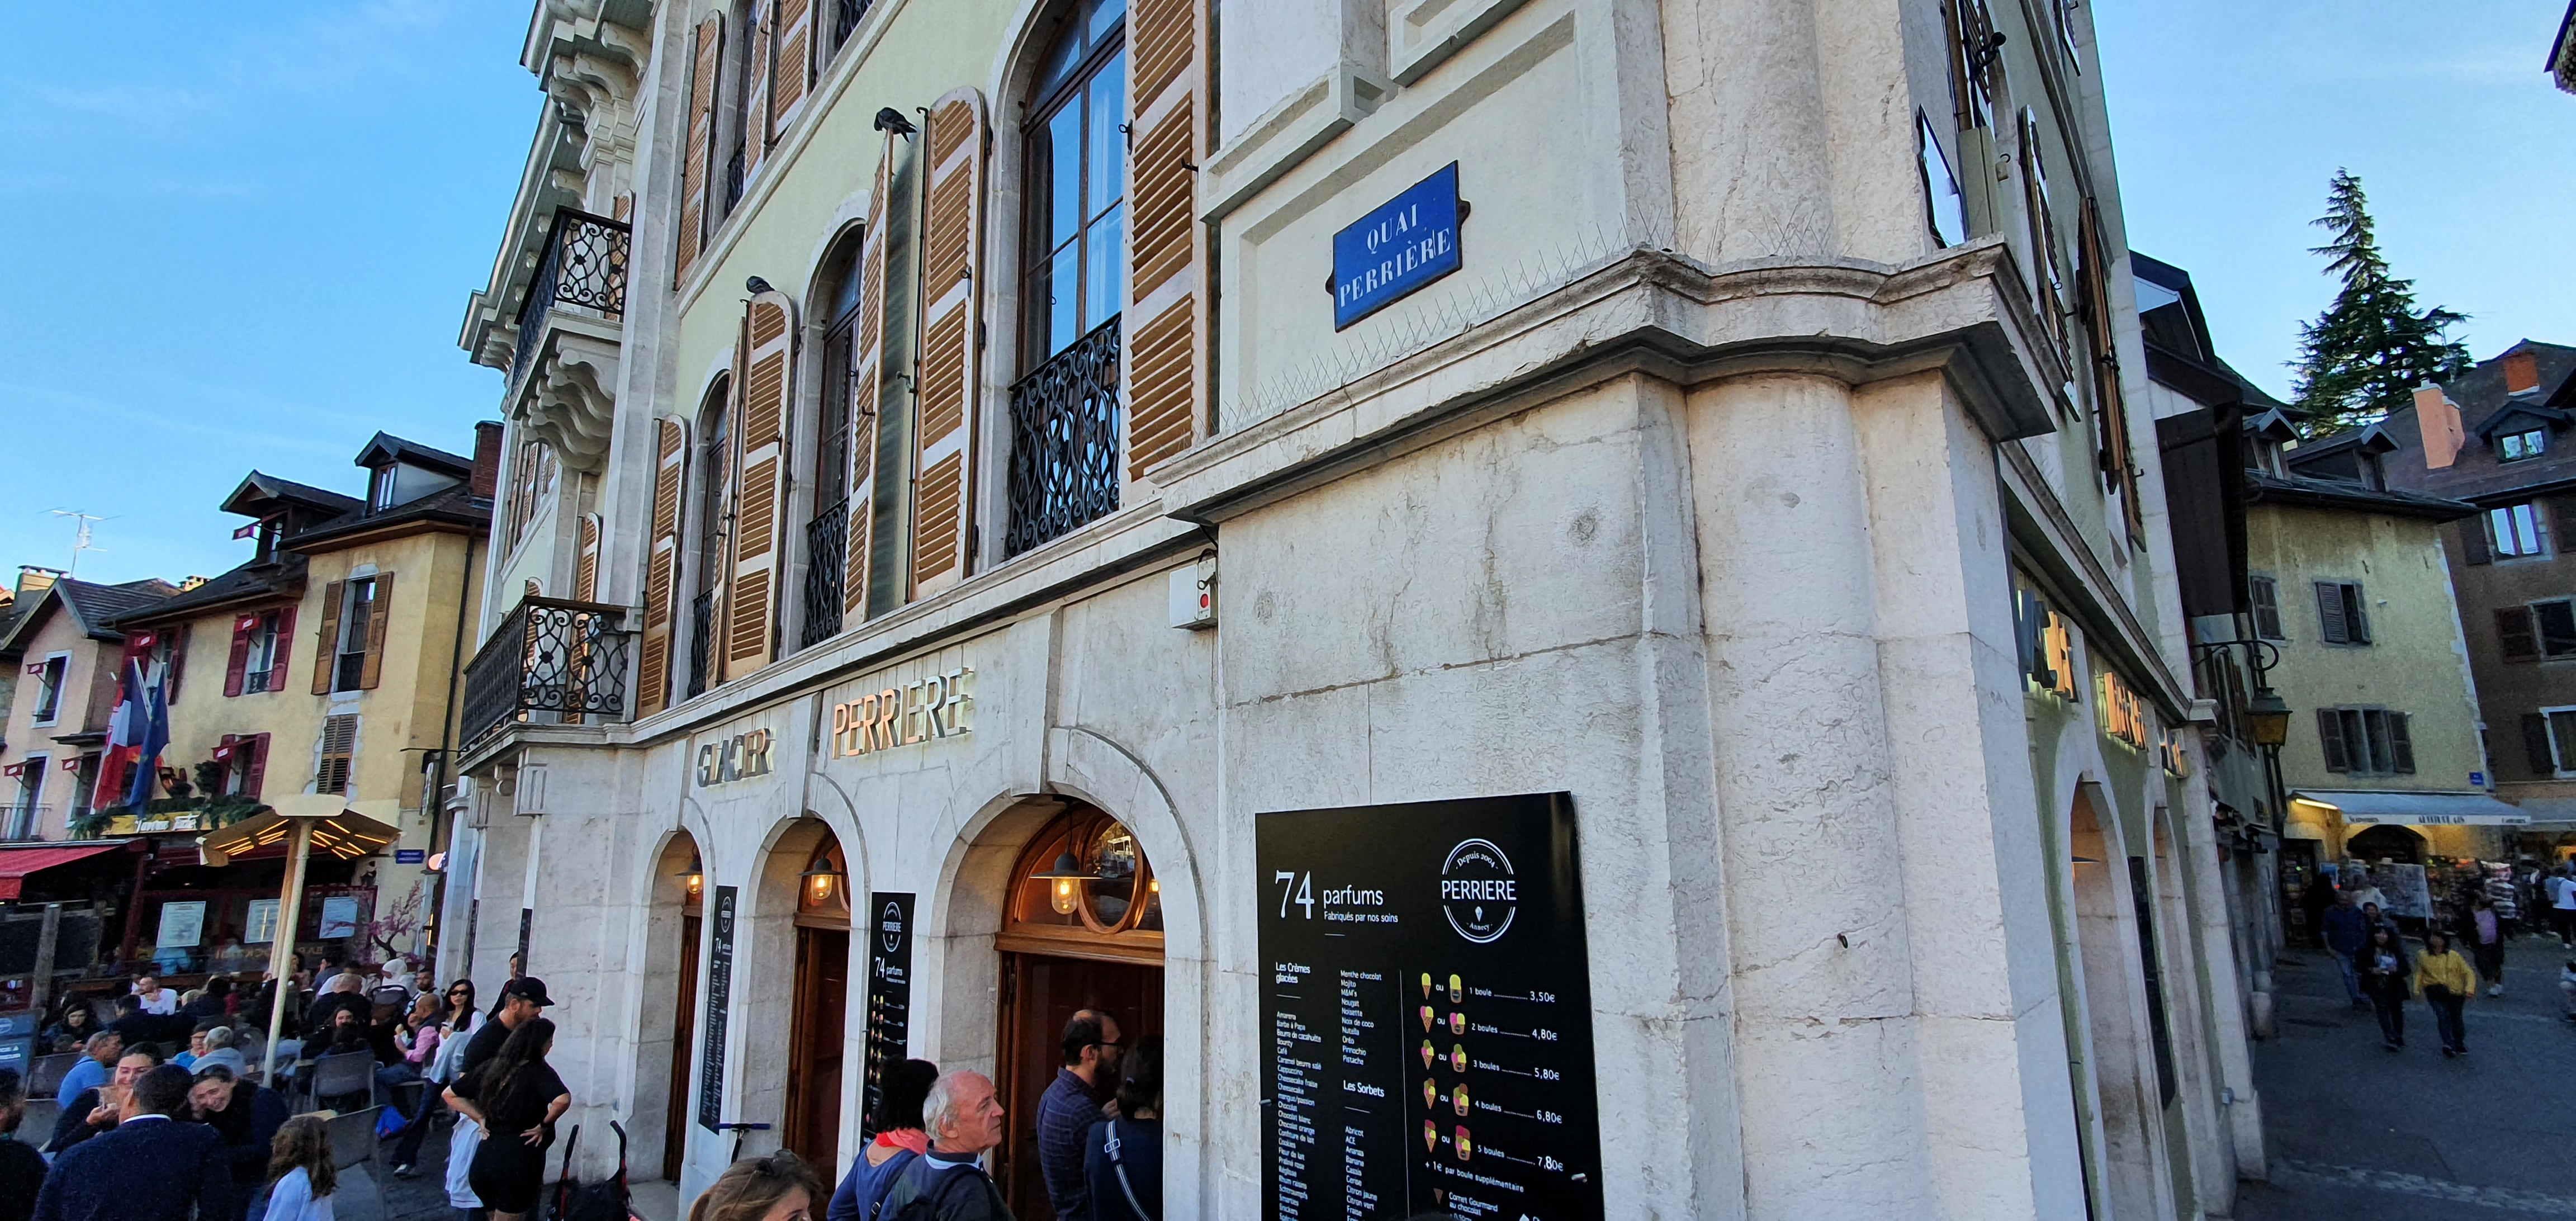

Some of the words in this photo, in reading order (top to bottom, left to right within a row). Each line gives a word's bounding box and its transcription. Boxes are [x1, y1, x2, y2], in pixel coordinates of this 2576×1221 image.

[1367, 202, 1418, 255] QUAI
[1340, 228, 1451, 308] PERRIÈRE
[832, 668, 970, 760] PERRIERE
[697, 728, 776, 788] GLACIER
[1457, 850, 1480, 868] Depuis
[1480, 853, 1495, 868] 2004
[1275, 870, 1315, 920] 74
[1323, 884, 1384, 909] parfums
[1441, 879, 1517, 901] PERRIERE
[1324, 911, 1354, 923] Fabriqués
[1355, 913, 1366, 924] par
[1367, 914, 1379, 922] nos
[1381, 913, 1399, 923] soins
[875, 955, 885, 978] 74
[1276, 961, 1286, 972] Les
[1287, 962, 1310, 974] Crèmes
[1340, 970, 1359, 979] Menthe
[1360, 971, 1381, 981] chocolat
[1341, 979, 1356, 988] Mojito
[1341, 998, 1360, 1007] Nougat
[1475, 988, 1492, 997] boule
[1530, 991, 1555, 1003] 3,50€
[1342, 1007, 1363, 1017] Noisette
[1342, 1016, 1352, 1025] Noix
[1477, 1023, 1498, 1034] boules
[1532, 1029, 1557, 1041] 4,80€
[1343, 1054, 1364, 1066] Pistache
[1479, 1060, 1500, 1071] boules
[1534, 1067, 1560, 1081] 5,80€
[1343, 1080, 1356, 1091] Les
[1357, 1081, 1385, 1097] Sorbets
[1440, 1094, 1448, 1102] ou
[1481, 1101, 1502, 1113] boules
[1537, 1110, 1562, 1124] 6,80€
[1345, 1125, 1364, 1138] Abricot
[1345, 1135, 1356, 1145] ACE
[1441, 1135, 1450, 1144] ou
[1484, 1146, 1505, 1158] boules
[1537, 1156, 1564, 1172] 7,80€
[1433, 1161, 1442, 1172] 1€
[1445, 1166, 1455, 1175] par
[1457, 1168, 1474, 1181] boule
[1475, 1173, 1524, 1192] supplémentaire
[1346, 1185, 1362, 1196] Citron
[1363, 1190, 1377, 1201] jaune
[1449, 1191, 1468, 1204] Cornet
[1469, 1197, 1498, 1212] Gourmand
[1457, 1203, 1482, 1217] chocolat
